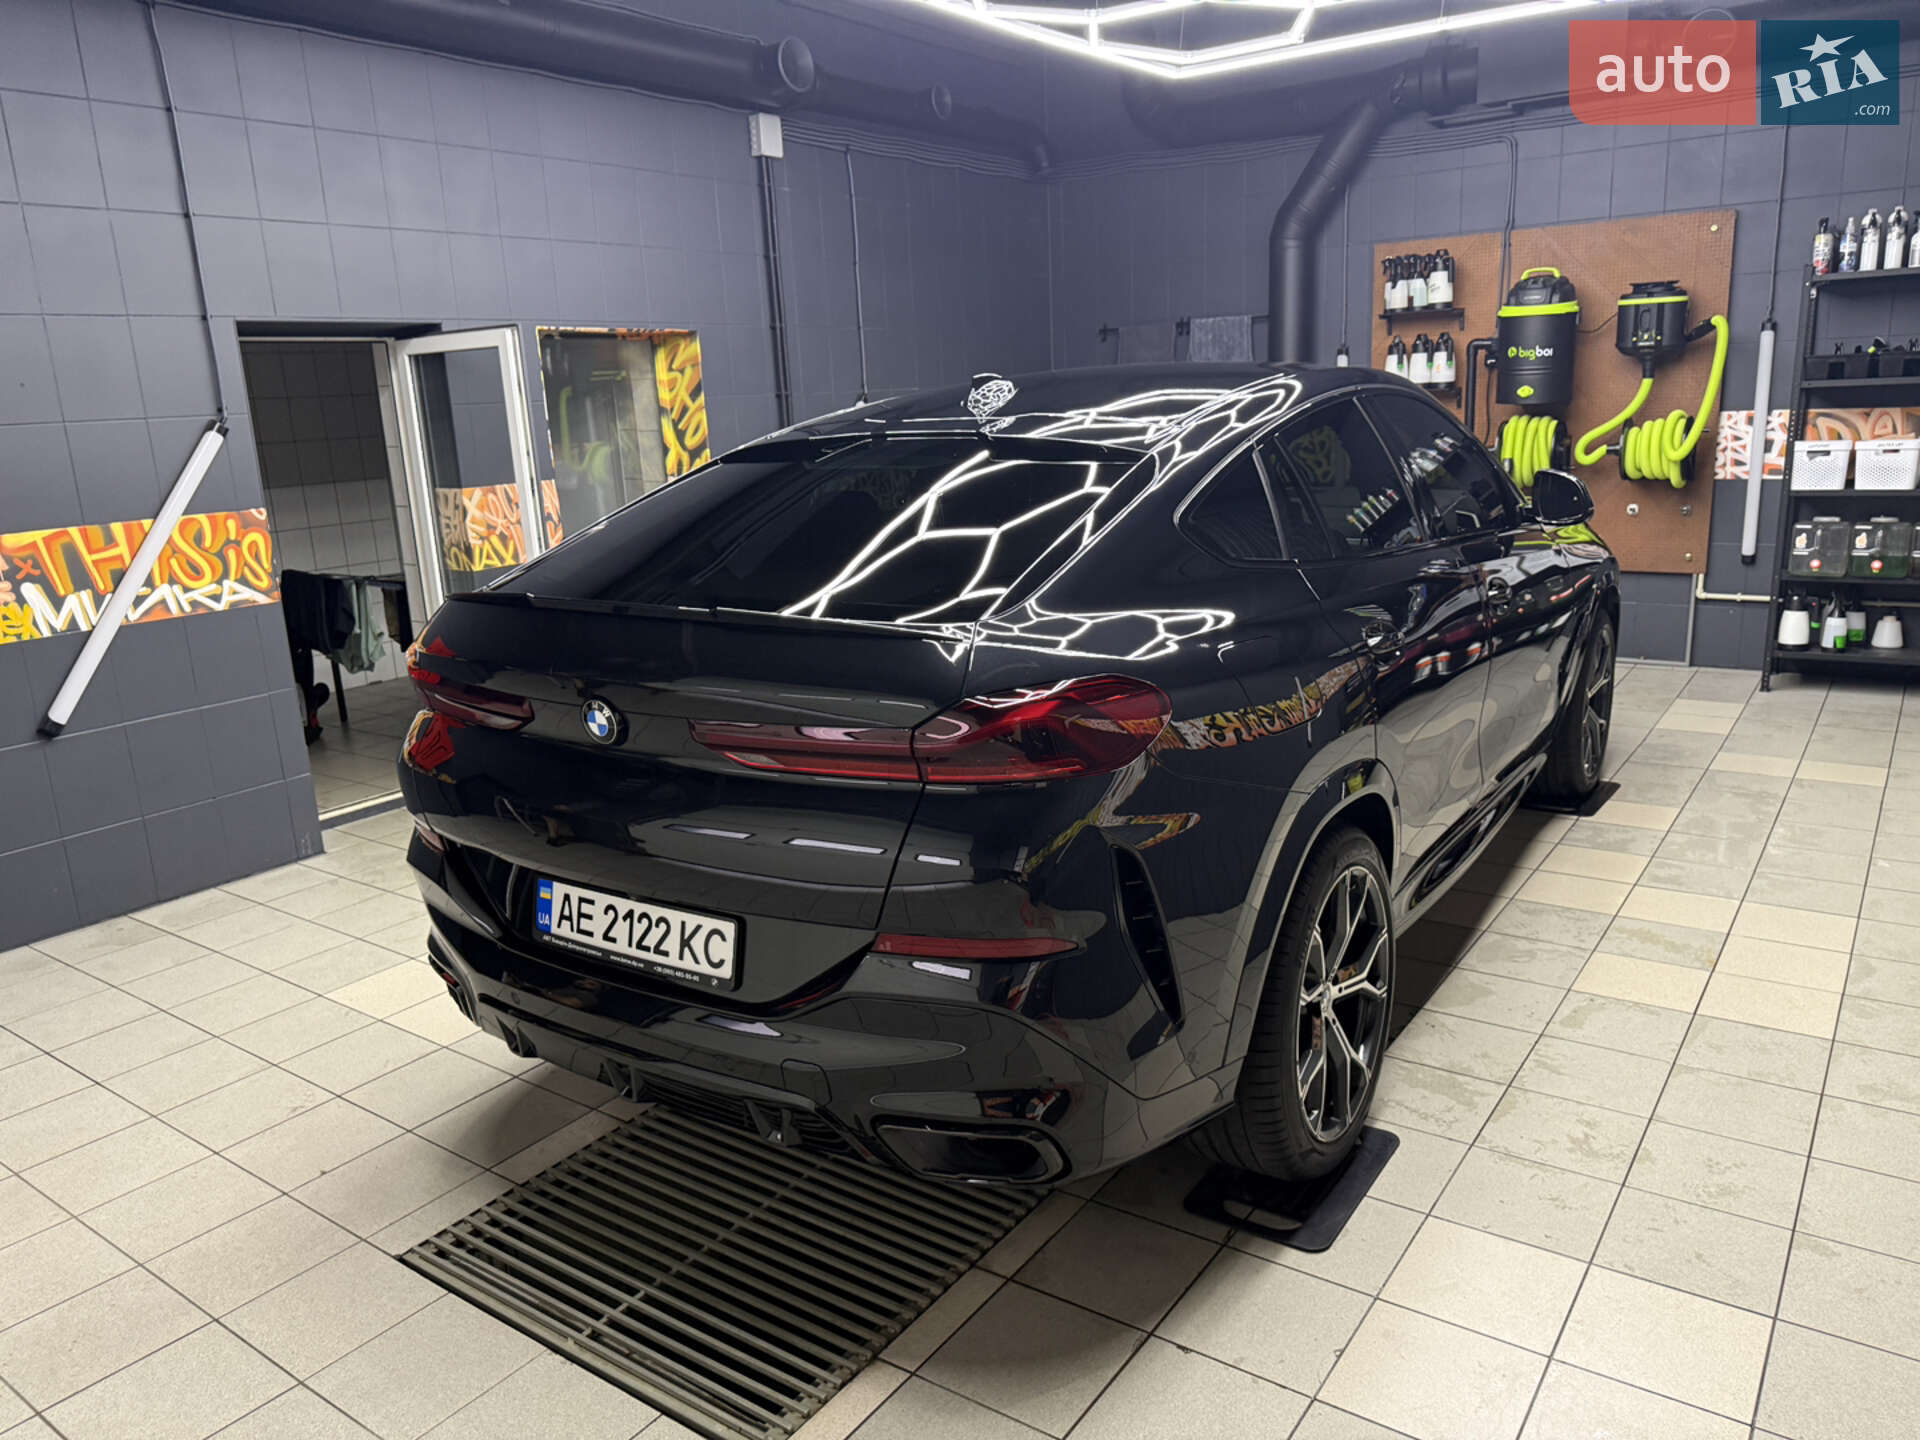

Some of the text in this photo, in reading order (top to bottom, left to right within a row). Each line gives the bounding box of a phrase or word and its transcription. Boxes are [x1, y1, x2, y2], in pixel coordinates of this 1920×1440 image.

[538, 912, 551, 926] UA
[557, 893, 596, 938] AE
[602, 903, 672, 958] 2122
[678, 920, 728, 969] KC
